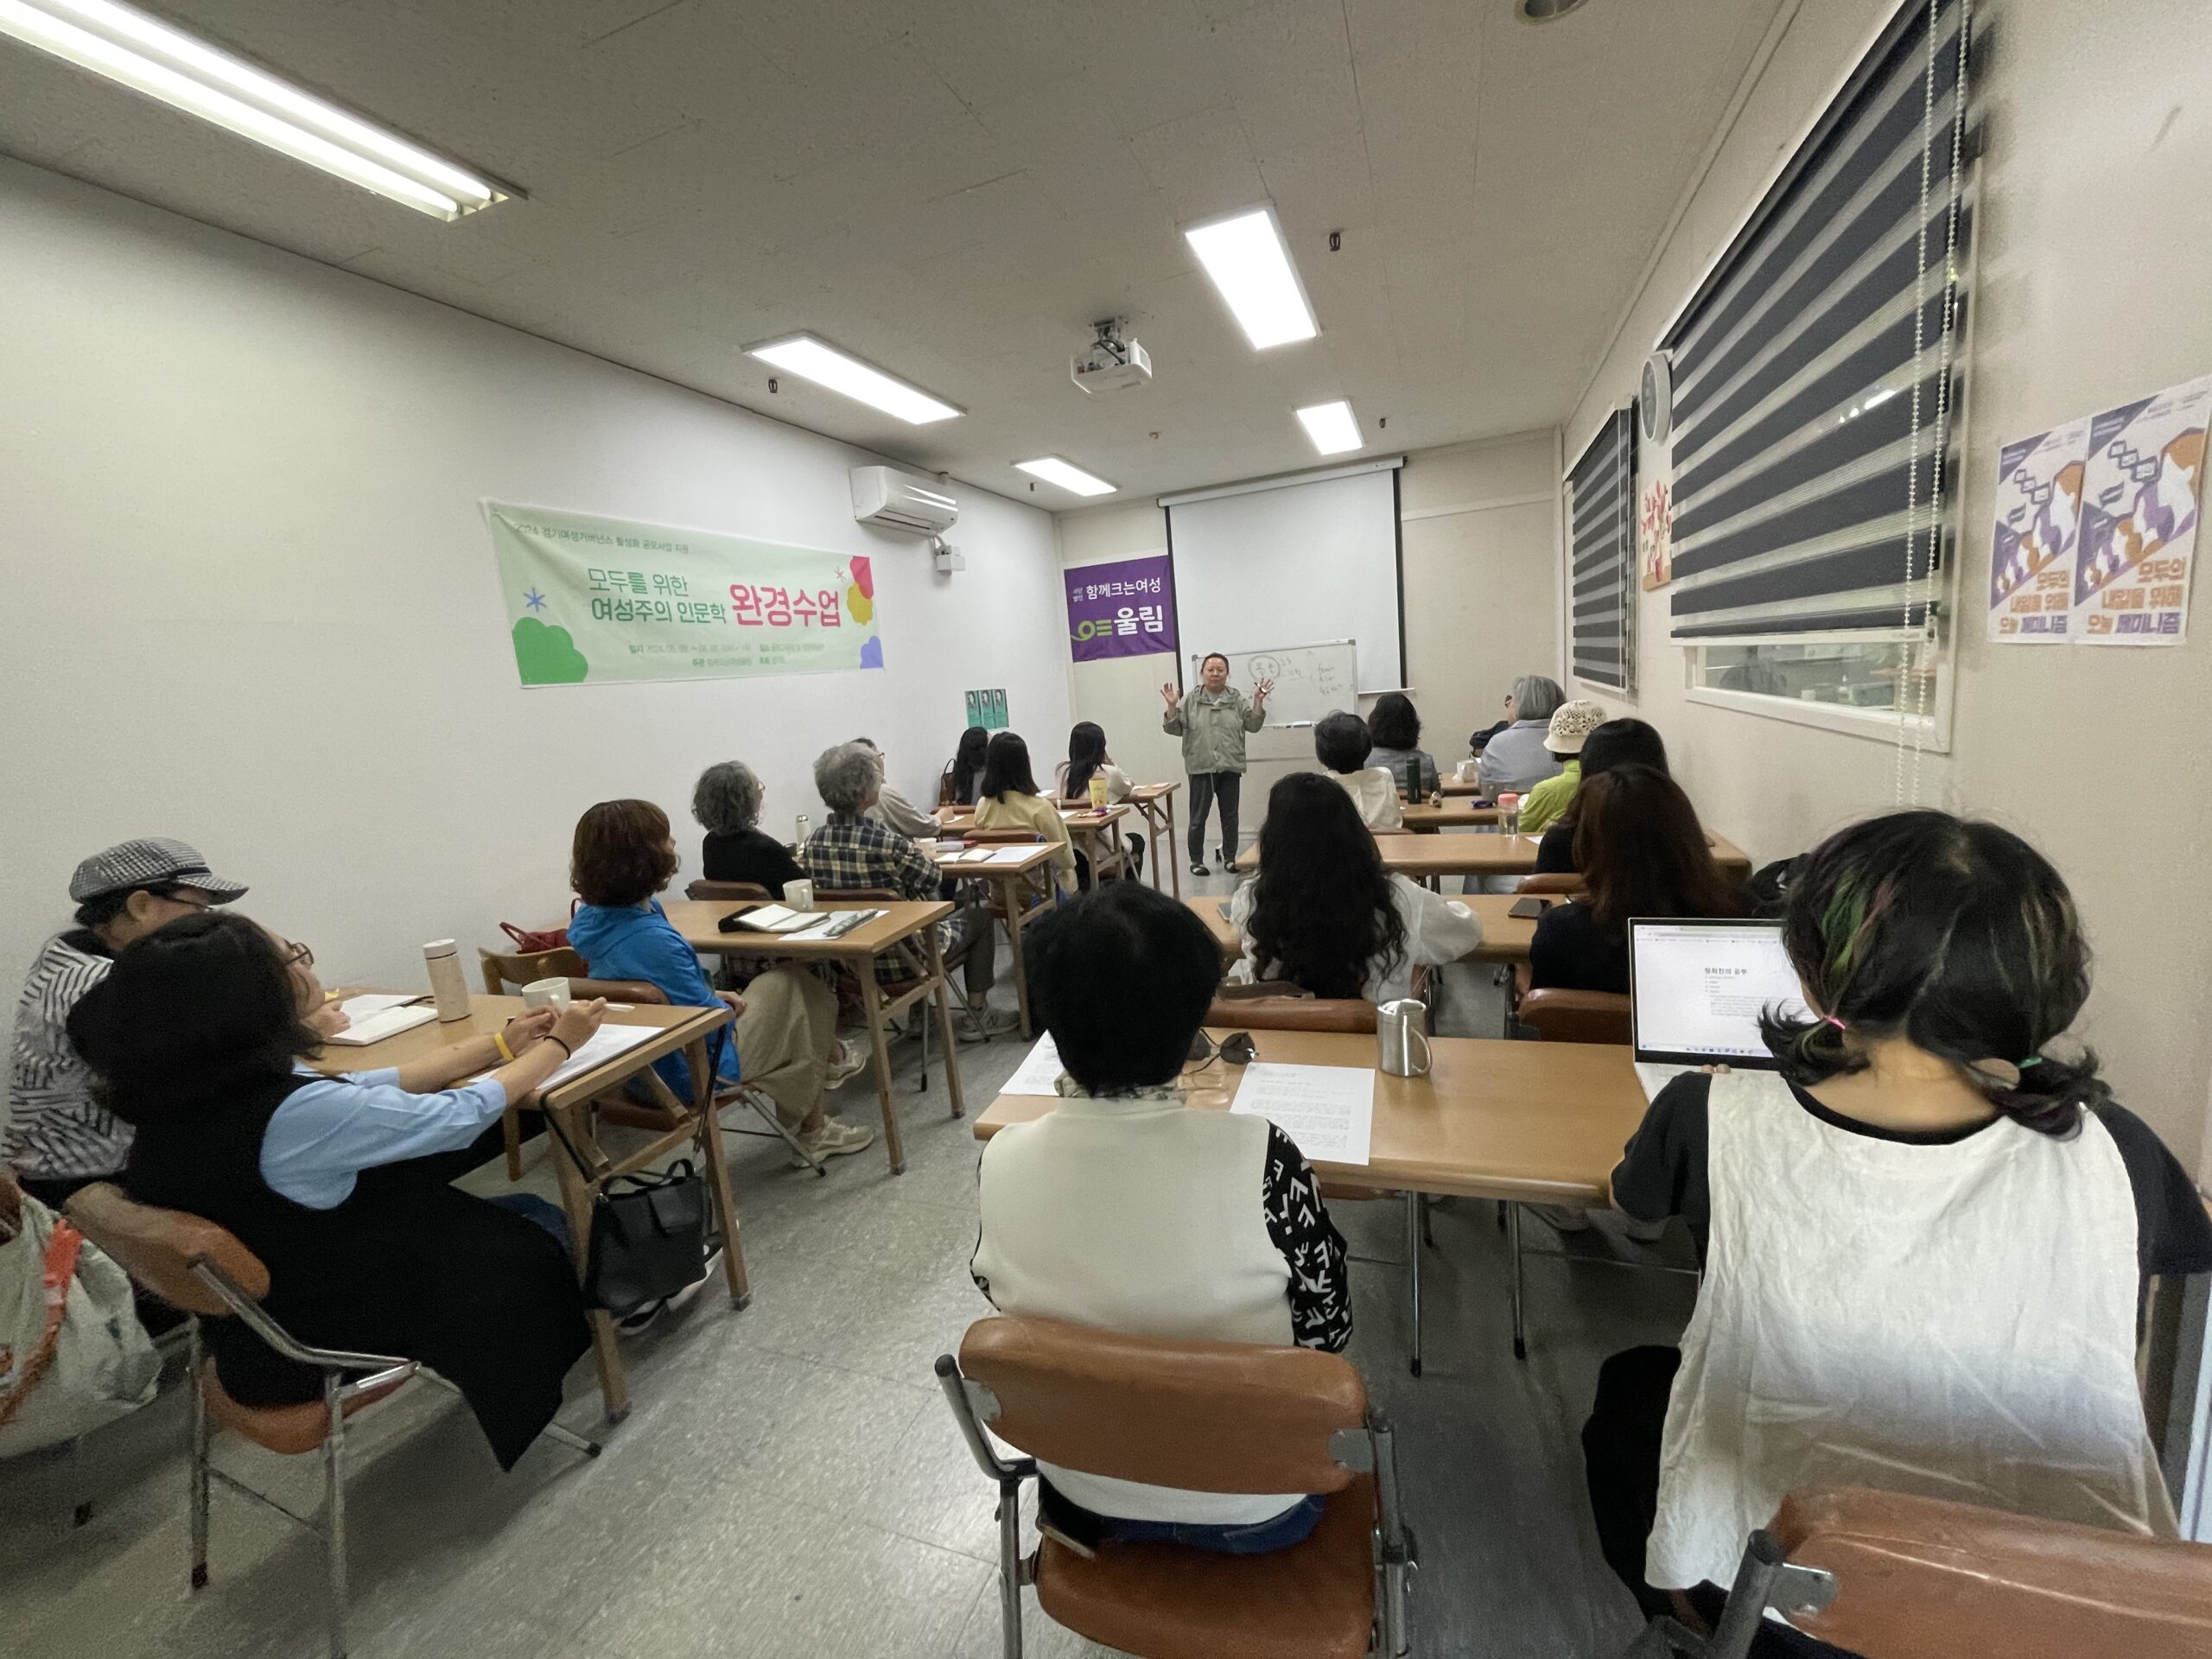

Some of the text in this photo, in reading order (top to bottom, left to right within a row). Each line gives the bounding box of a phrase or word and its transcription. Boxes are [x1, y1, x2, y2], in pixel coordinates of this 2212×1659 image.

[643, 539, 672, 552] 공모사업
[588, 568, 690, 597] 모두를 위한
[1086, 577, 1161, 600] 함께크는여성
[591, 597, 727, 625] 여성주의 인문학
[729, 583, 842, 627] 완경수업
[1114, 605, 1163, 636] 울림
